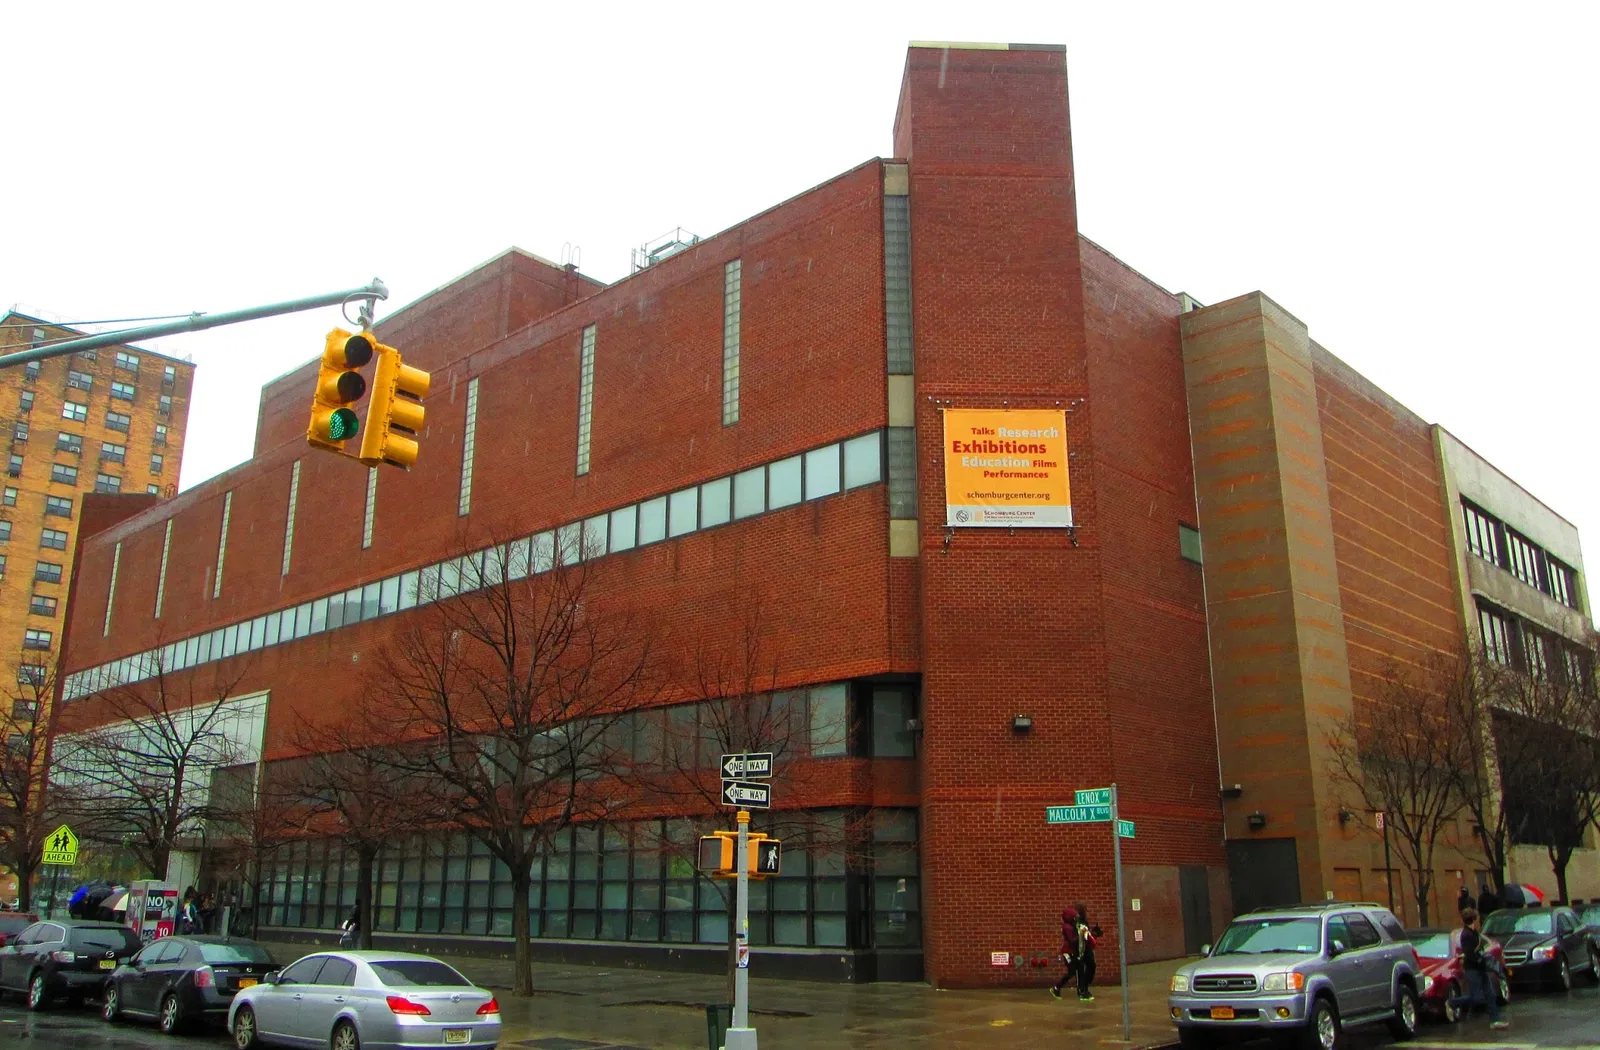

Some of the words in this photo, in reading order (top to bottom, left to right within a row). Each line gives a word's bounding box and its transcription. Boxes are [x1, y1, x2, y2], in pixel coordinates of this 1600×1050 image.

[971, 427, 995, 435] Talks
[998, 427, 1058, 437] Research
[952, 440, 1047, 454] Exhibitions
[962, 456, 1030, 467] Education
[1033, 460, 1057, 468] Films
[983, 470, 1049, 478] Performances
[967, 491, 1050, 500] schomburgcenter.org
[729, 762, 743, 771] ONE
[750, 761, 764, 770] WAY
[730, 788, 743, 798] ONE
[750, 790, 764, 800] WAY
[1077, 791, 1100, 805] LENOX
[1049, 808, 1086, 821] MALCOLM
[1090, 808, 1096, 819] X
[46, 853, 72, 862] AHEAD
[147, 896, 164, 907] NO
